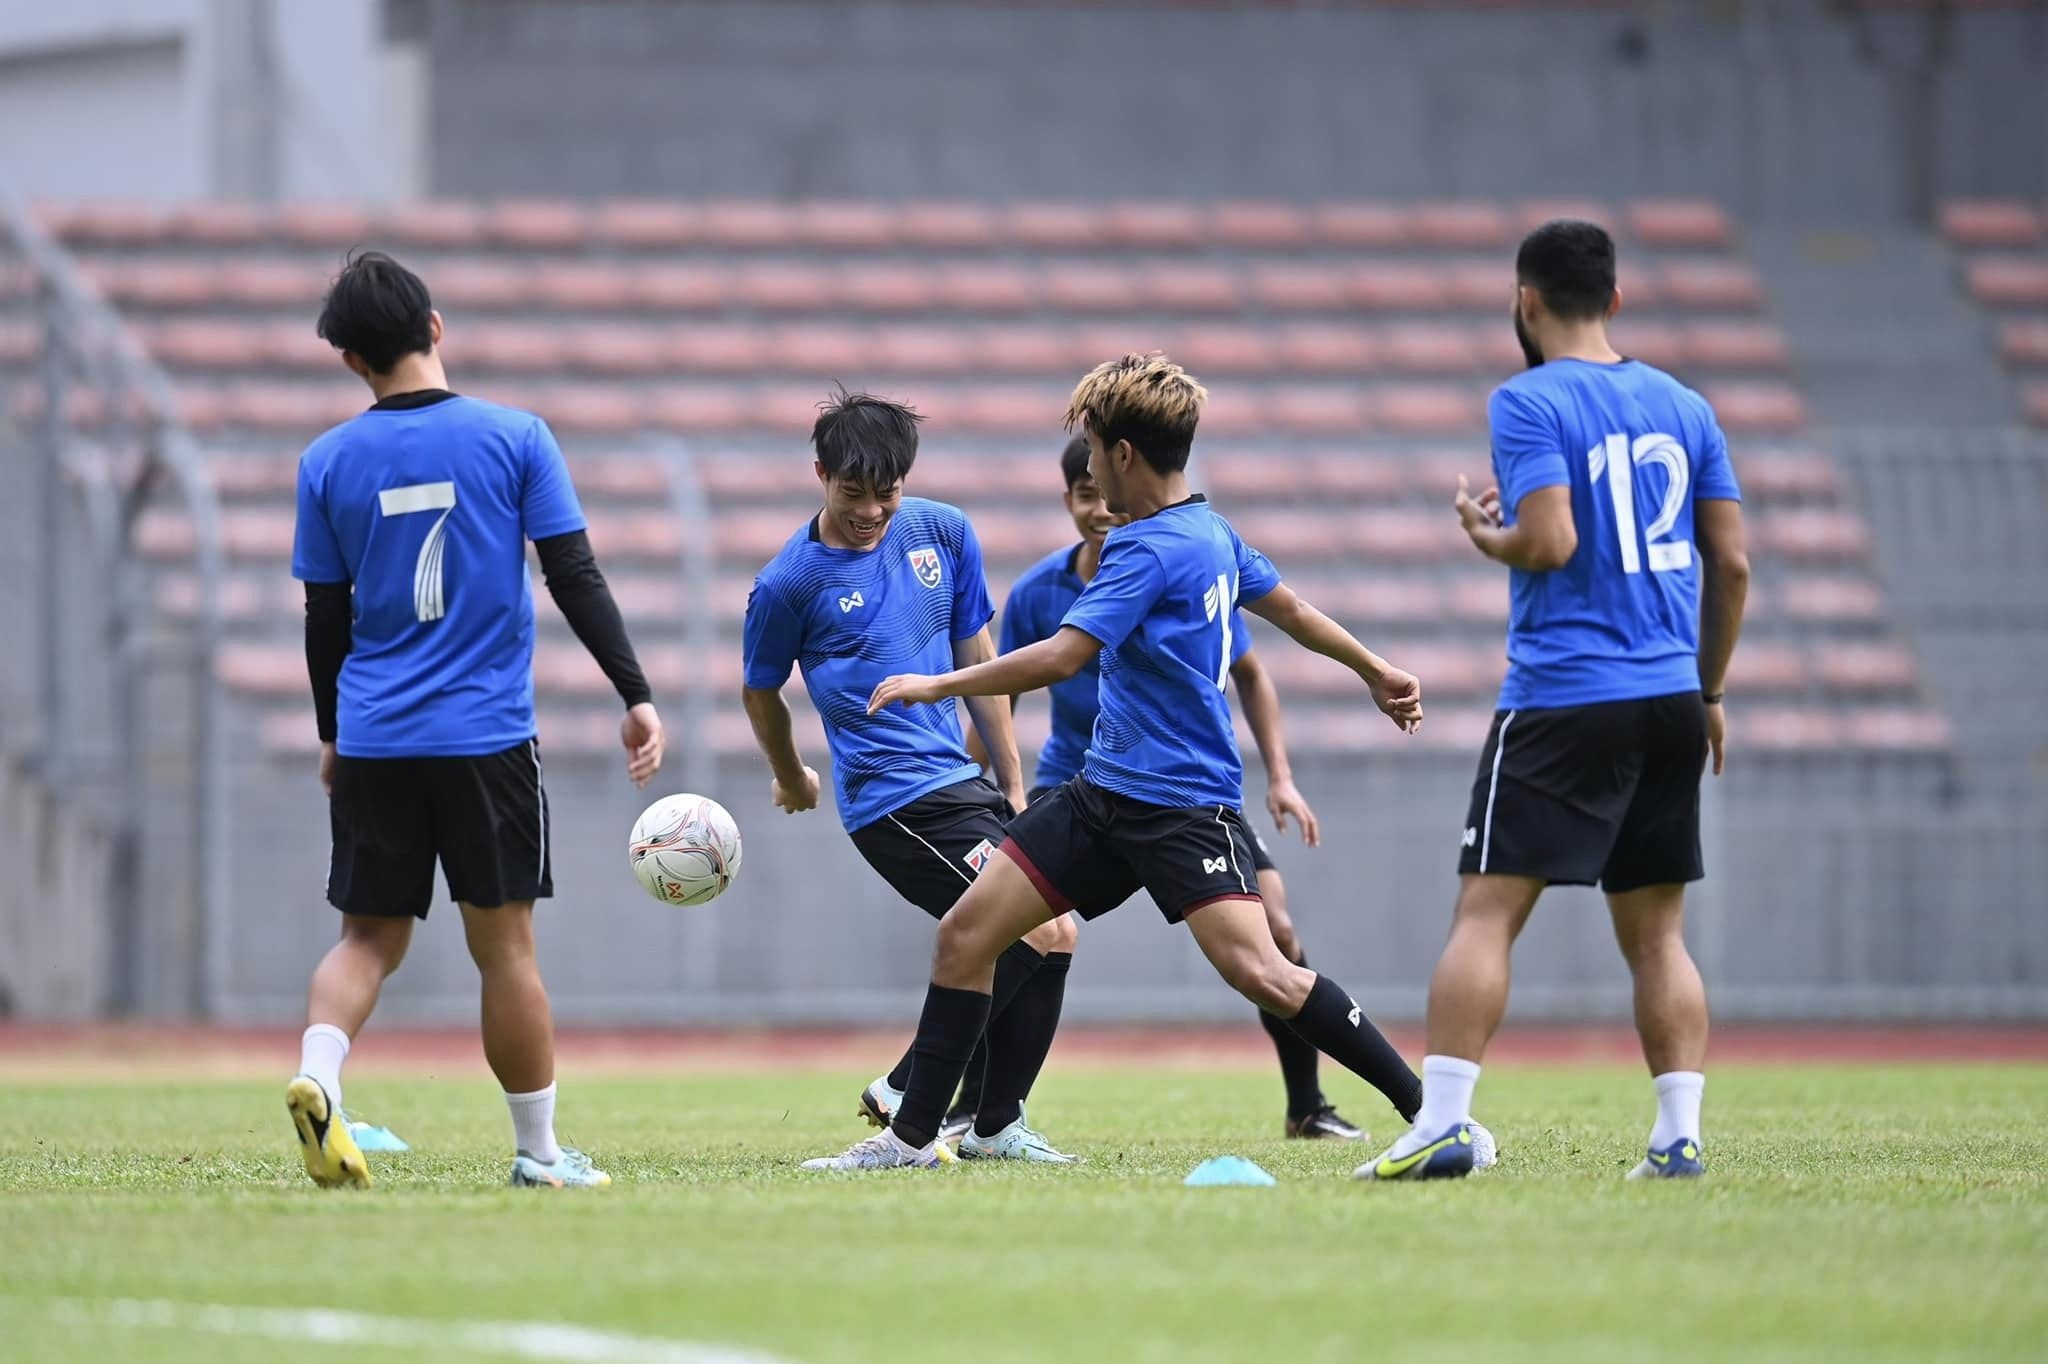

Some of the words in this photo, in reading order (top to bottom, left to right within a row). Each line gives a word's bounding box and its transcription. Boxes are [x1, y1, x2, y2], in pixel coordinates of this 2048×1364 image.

[378, 481, 456, 623] 7
[1587, 432, 1692, 574] 12
[1203, 569, 1240, 694] 1
